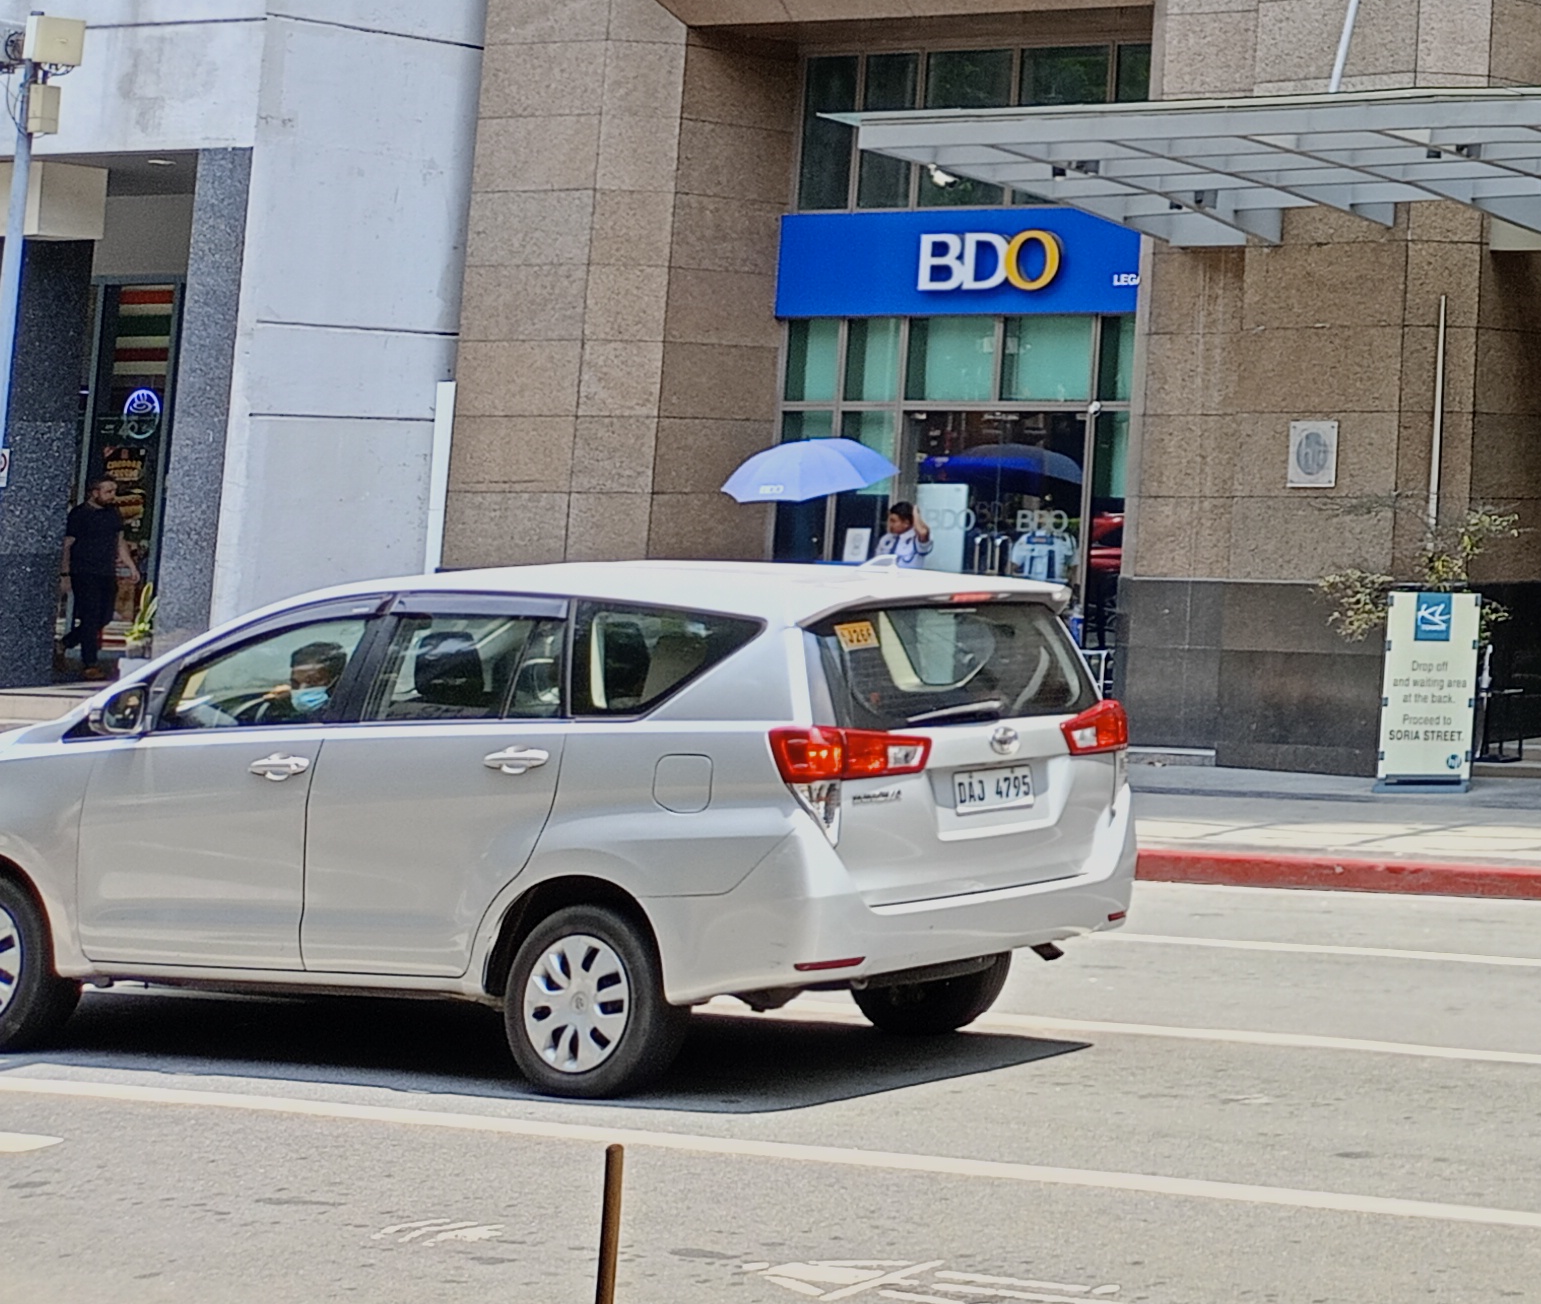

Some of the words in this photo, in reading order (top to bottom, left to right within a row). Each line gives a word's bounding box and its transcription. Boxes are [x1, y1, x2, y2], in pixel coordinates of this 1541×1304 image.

[917, 229, 1064, 292] BDO
[1016, 509, 1068, 533] BDO
[1411, 660, 1434, 673] Drop
[1436, 661, 1448, 672] off
[1393, 678, 1410, 687] and
[1412, 678, 1444, 690] waiting
[1447, 679, 1467, 688] area
[1402, 694, 1411, 703] at
[1414, 694, 1428, 703] the
[1431, 694, 1456, 704] back.
[1402, 714, 1440, 725] Proceed
[1443, 715, 1452, 725] to
[1389, 729, 1420, 741] SORIA
[957, 779, 986, 804] DAJ
[995, 774, 1031, 800] 4795
